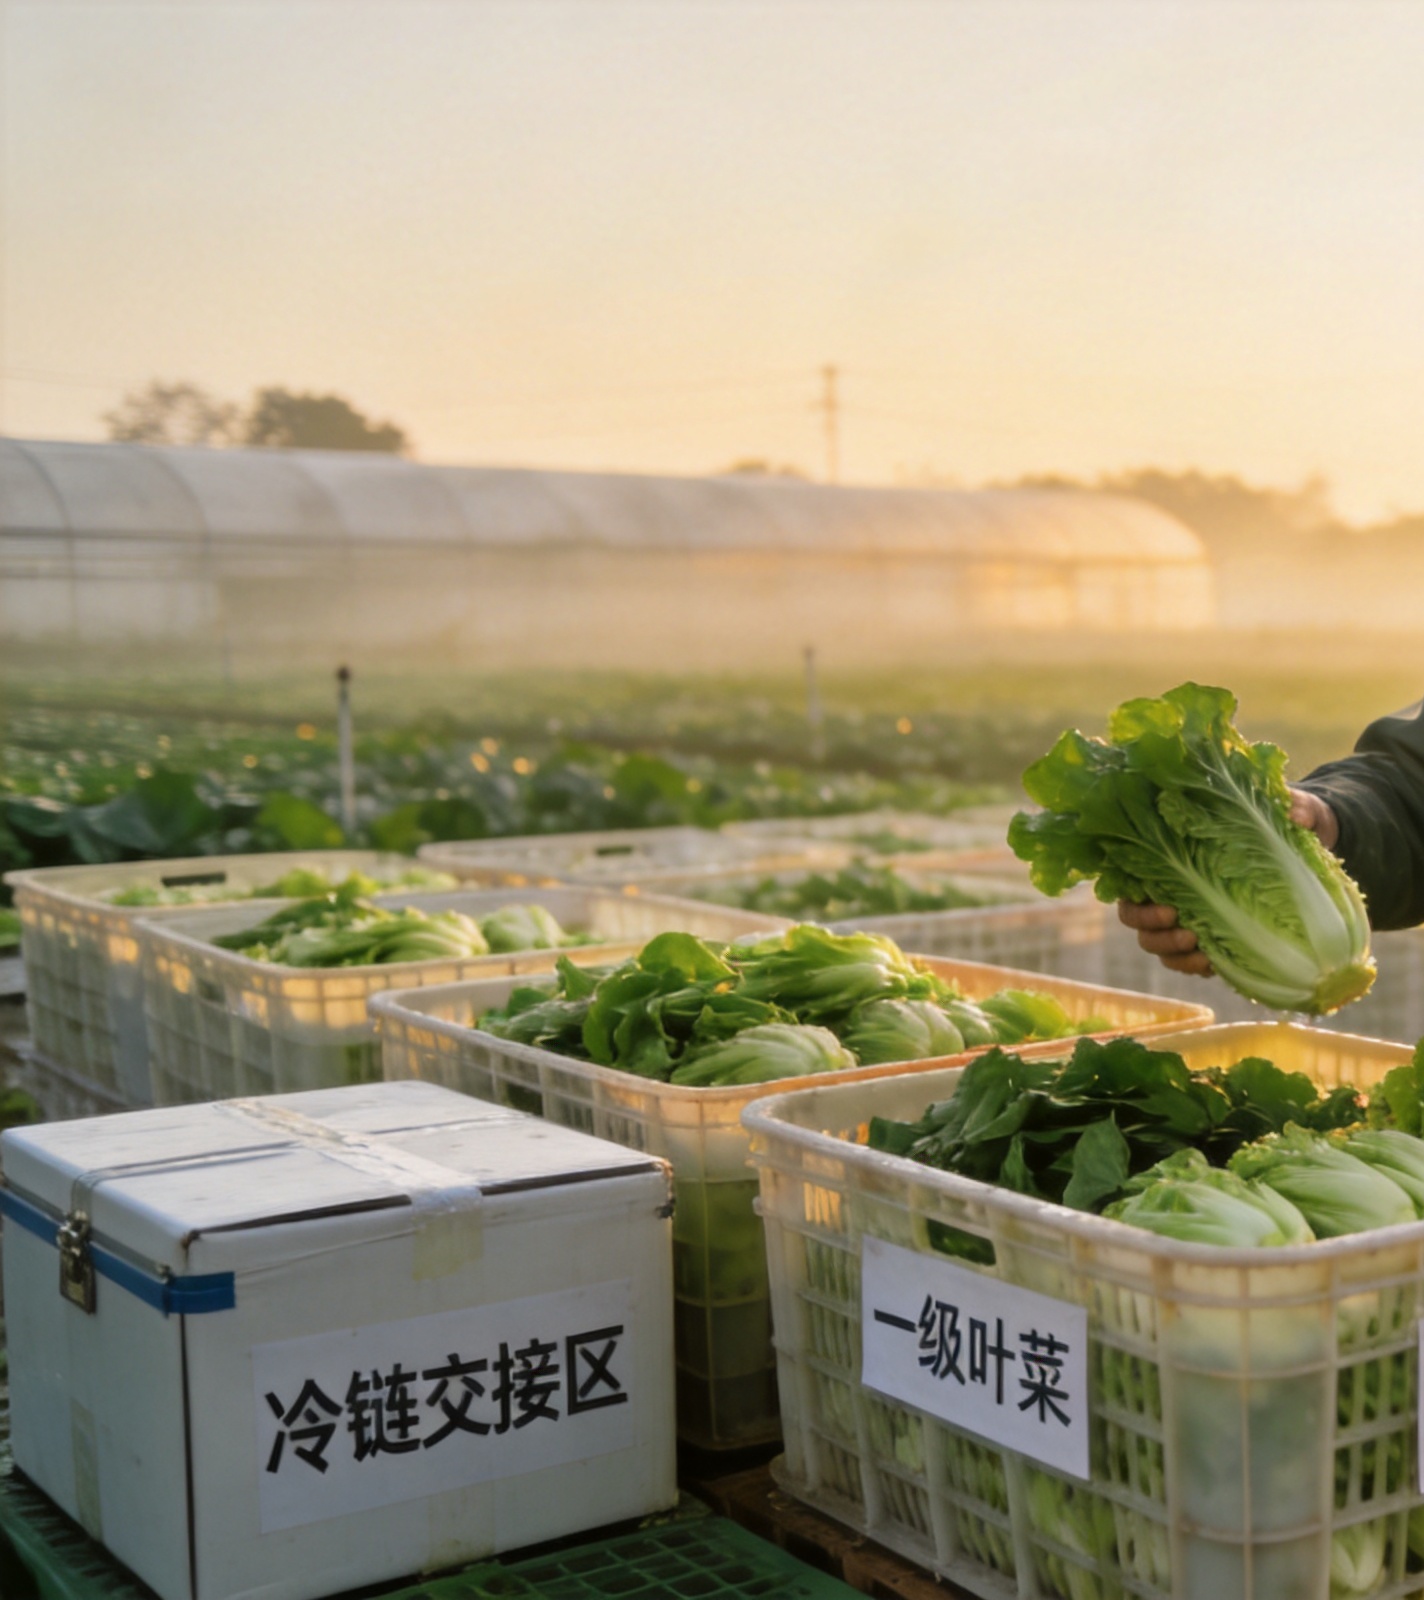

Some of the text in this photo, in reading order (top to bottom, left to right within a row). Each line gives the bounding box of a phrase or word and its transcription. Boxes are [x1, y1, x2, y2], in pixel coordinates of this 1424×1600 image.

[265, 1324, 628, 1474] 冷链交接区
[874, 1294, 1072, 1428] 一级叶菜
